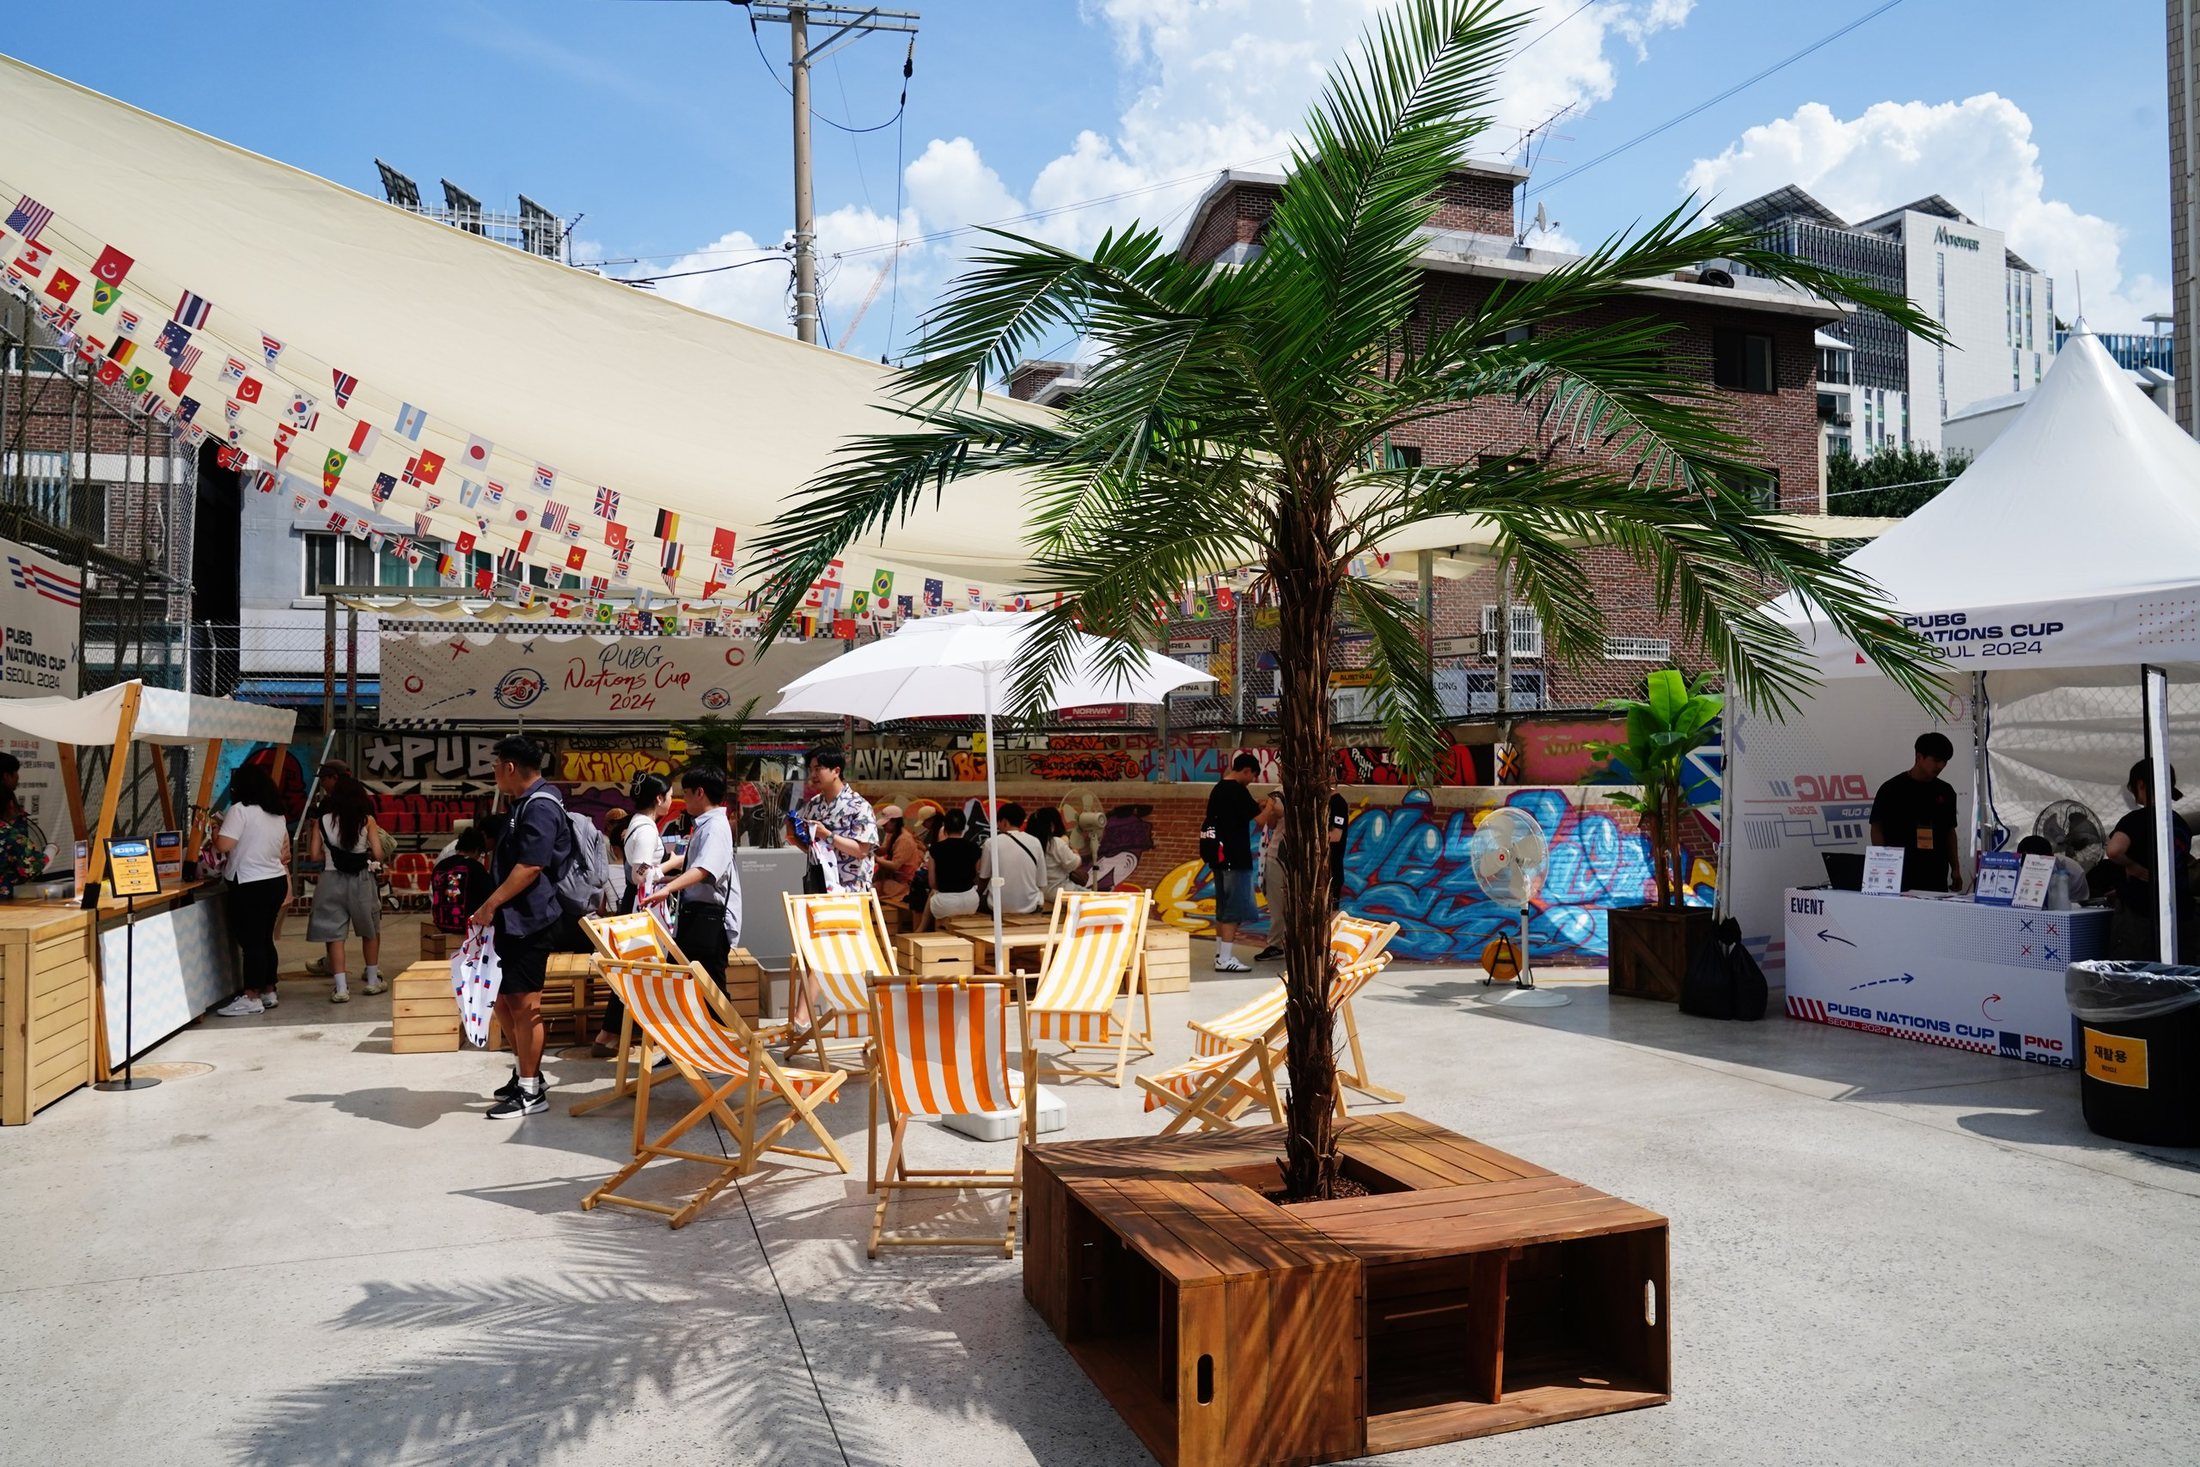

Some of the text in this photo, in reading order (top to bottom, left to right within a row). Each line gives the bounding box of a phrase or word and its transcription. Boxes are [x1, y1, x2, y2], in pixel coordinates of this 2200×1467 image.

[1904, 612, 1966, 629] PUBG
[6, 627, 32, 646] PUBG
[1918, 622, 2064, 643] ATIONS CUP
[598, 643, 664, 672] PUBG
[1982, 641, 2042, 656] 2024
[6, 646, 66, 671] NATIONS CUP
[6, 667, 60, 689] SEOUL 2024
[564, 657, 691, 695] Nations Cup
[609, 692, 656, 711] 2024
[402, 735, 551, 777] PUB
[855, 748, 902, 780] AVEX
[1791, 897, 1824, 915] EVENT
[1827, 1002, 1995, 1039] PUBG NATIONS CUP
[1827, 1017, 1888, 1034] SEOUL 2024
[2024, 1035, 2063, 1051] PNC
[2025, 1051, 2074, 1069] 2024
[2093, 1044, 2128, 1063] 재활용
